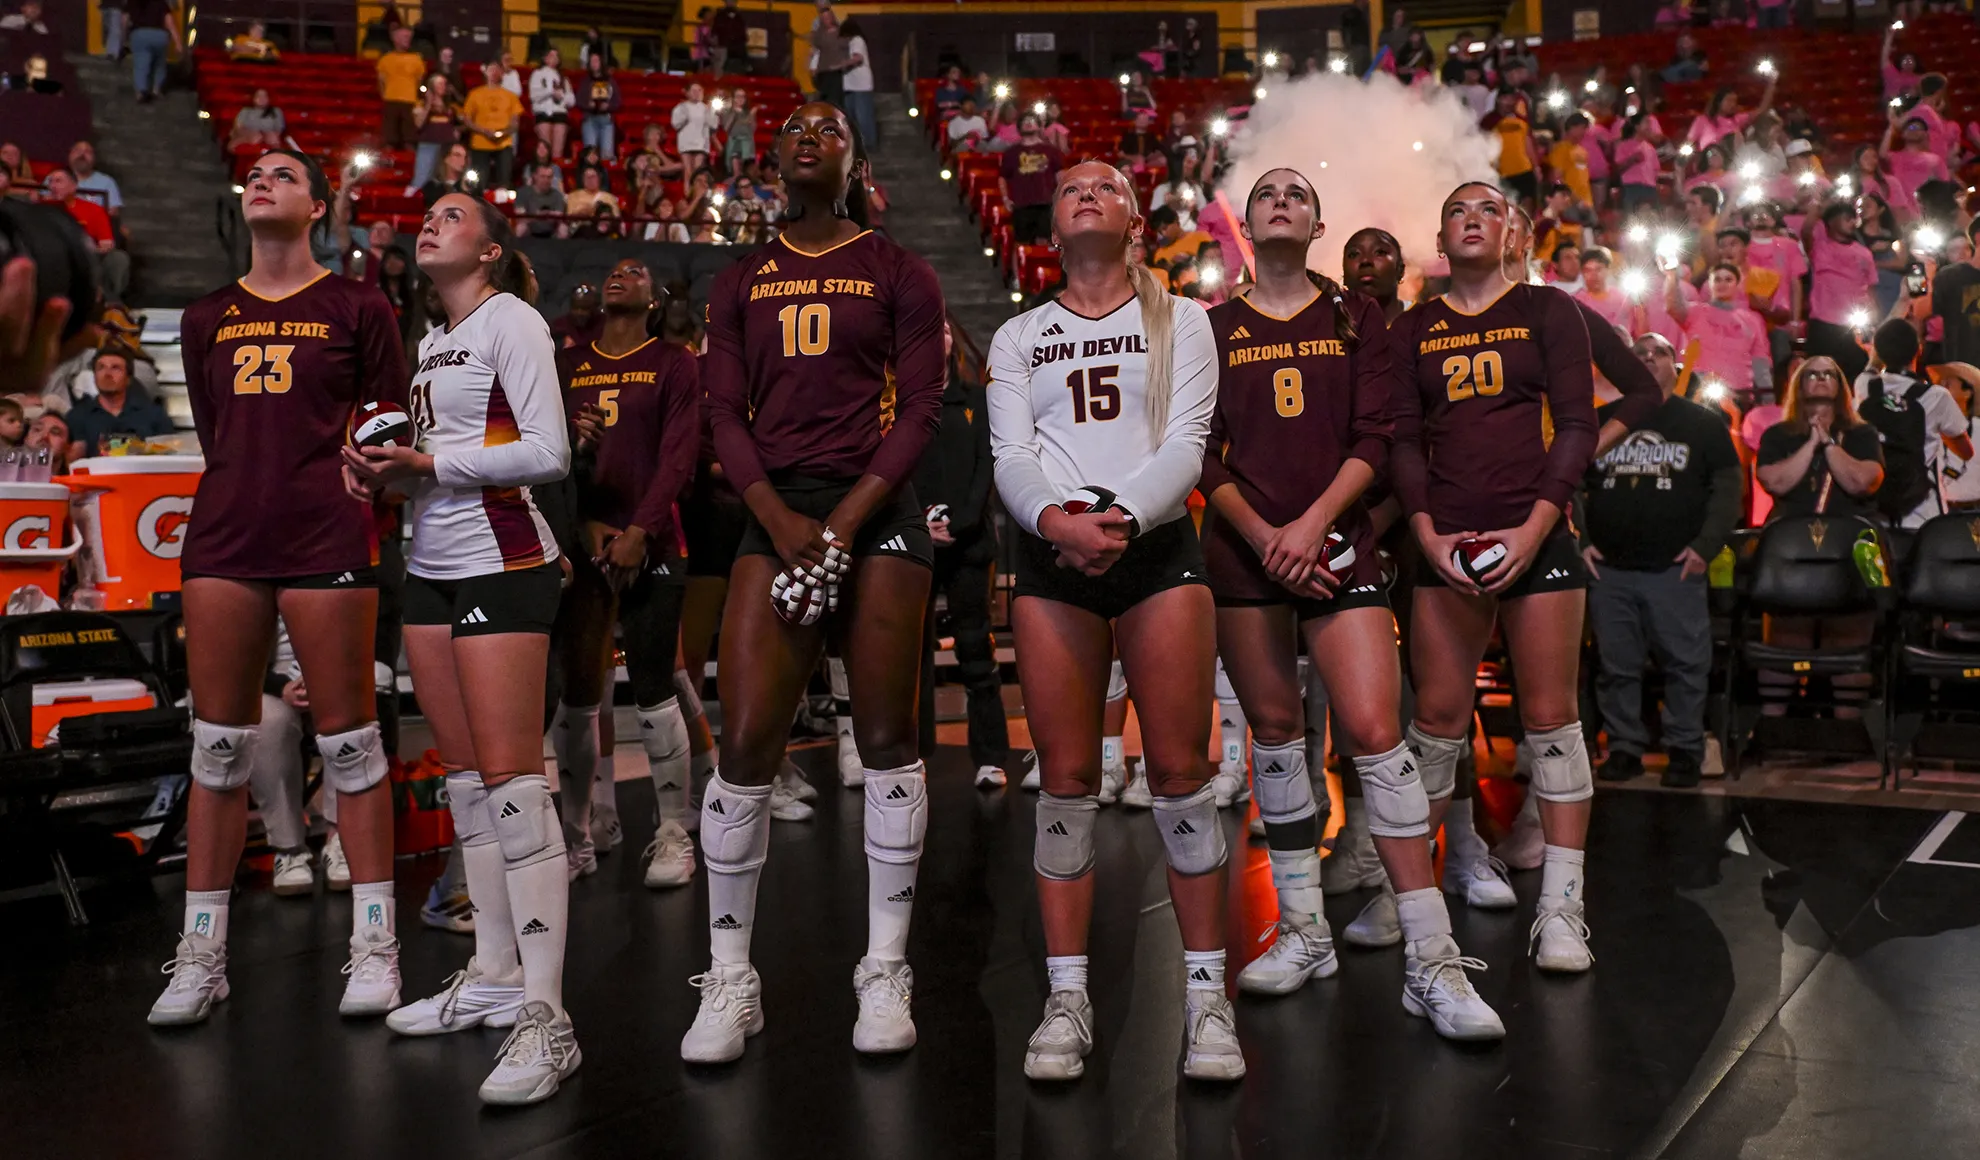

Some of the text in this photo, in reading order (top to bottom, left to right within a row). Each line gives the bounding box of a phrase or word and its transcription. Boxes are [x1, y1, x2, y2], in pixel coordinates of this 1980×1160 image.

[750, 278, 875, 301] ARIZONA STATE
[216, 321, 330, 343] ARIZONA STATE
[778, 303, 831, 357] 10
[1420, 327, 1530, 355] ARIZONA STATE
[1031, 334, 1149, 368] SUN DEVIL
[1228, 339, 1346, 367] ARIZONA STATE
[233, 344, 296, 395] 23
[570, 371, 657, 388] ARIZONA STATE
[1442, 350, 1504, 402] 20
[410, 380, 437, 431] 21
[599, 389, 620, 427] 5
[1066, 364, 1121, 424] 15
[1273, 367, 1304, 418] 8
[137, 495, 195, 559] G
[19, 628, 119, 648] ARIZONA STATE
[521, 926, 550, 936] adidas
[712, 921, 743, 930] adidas
